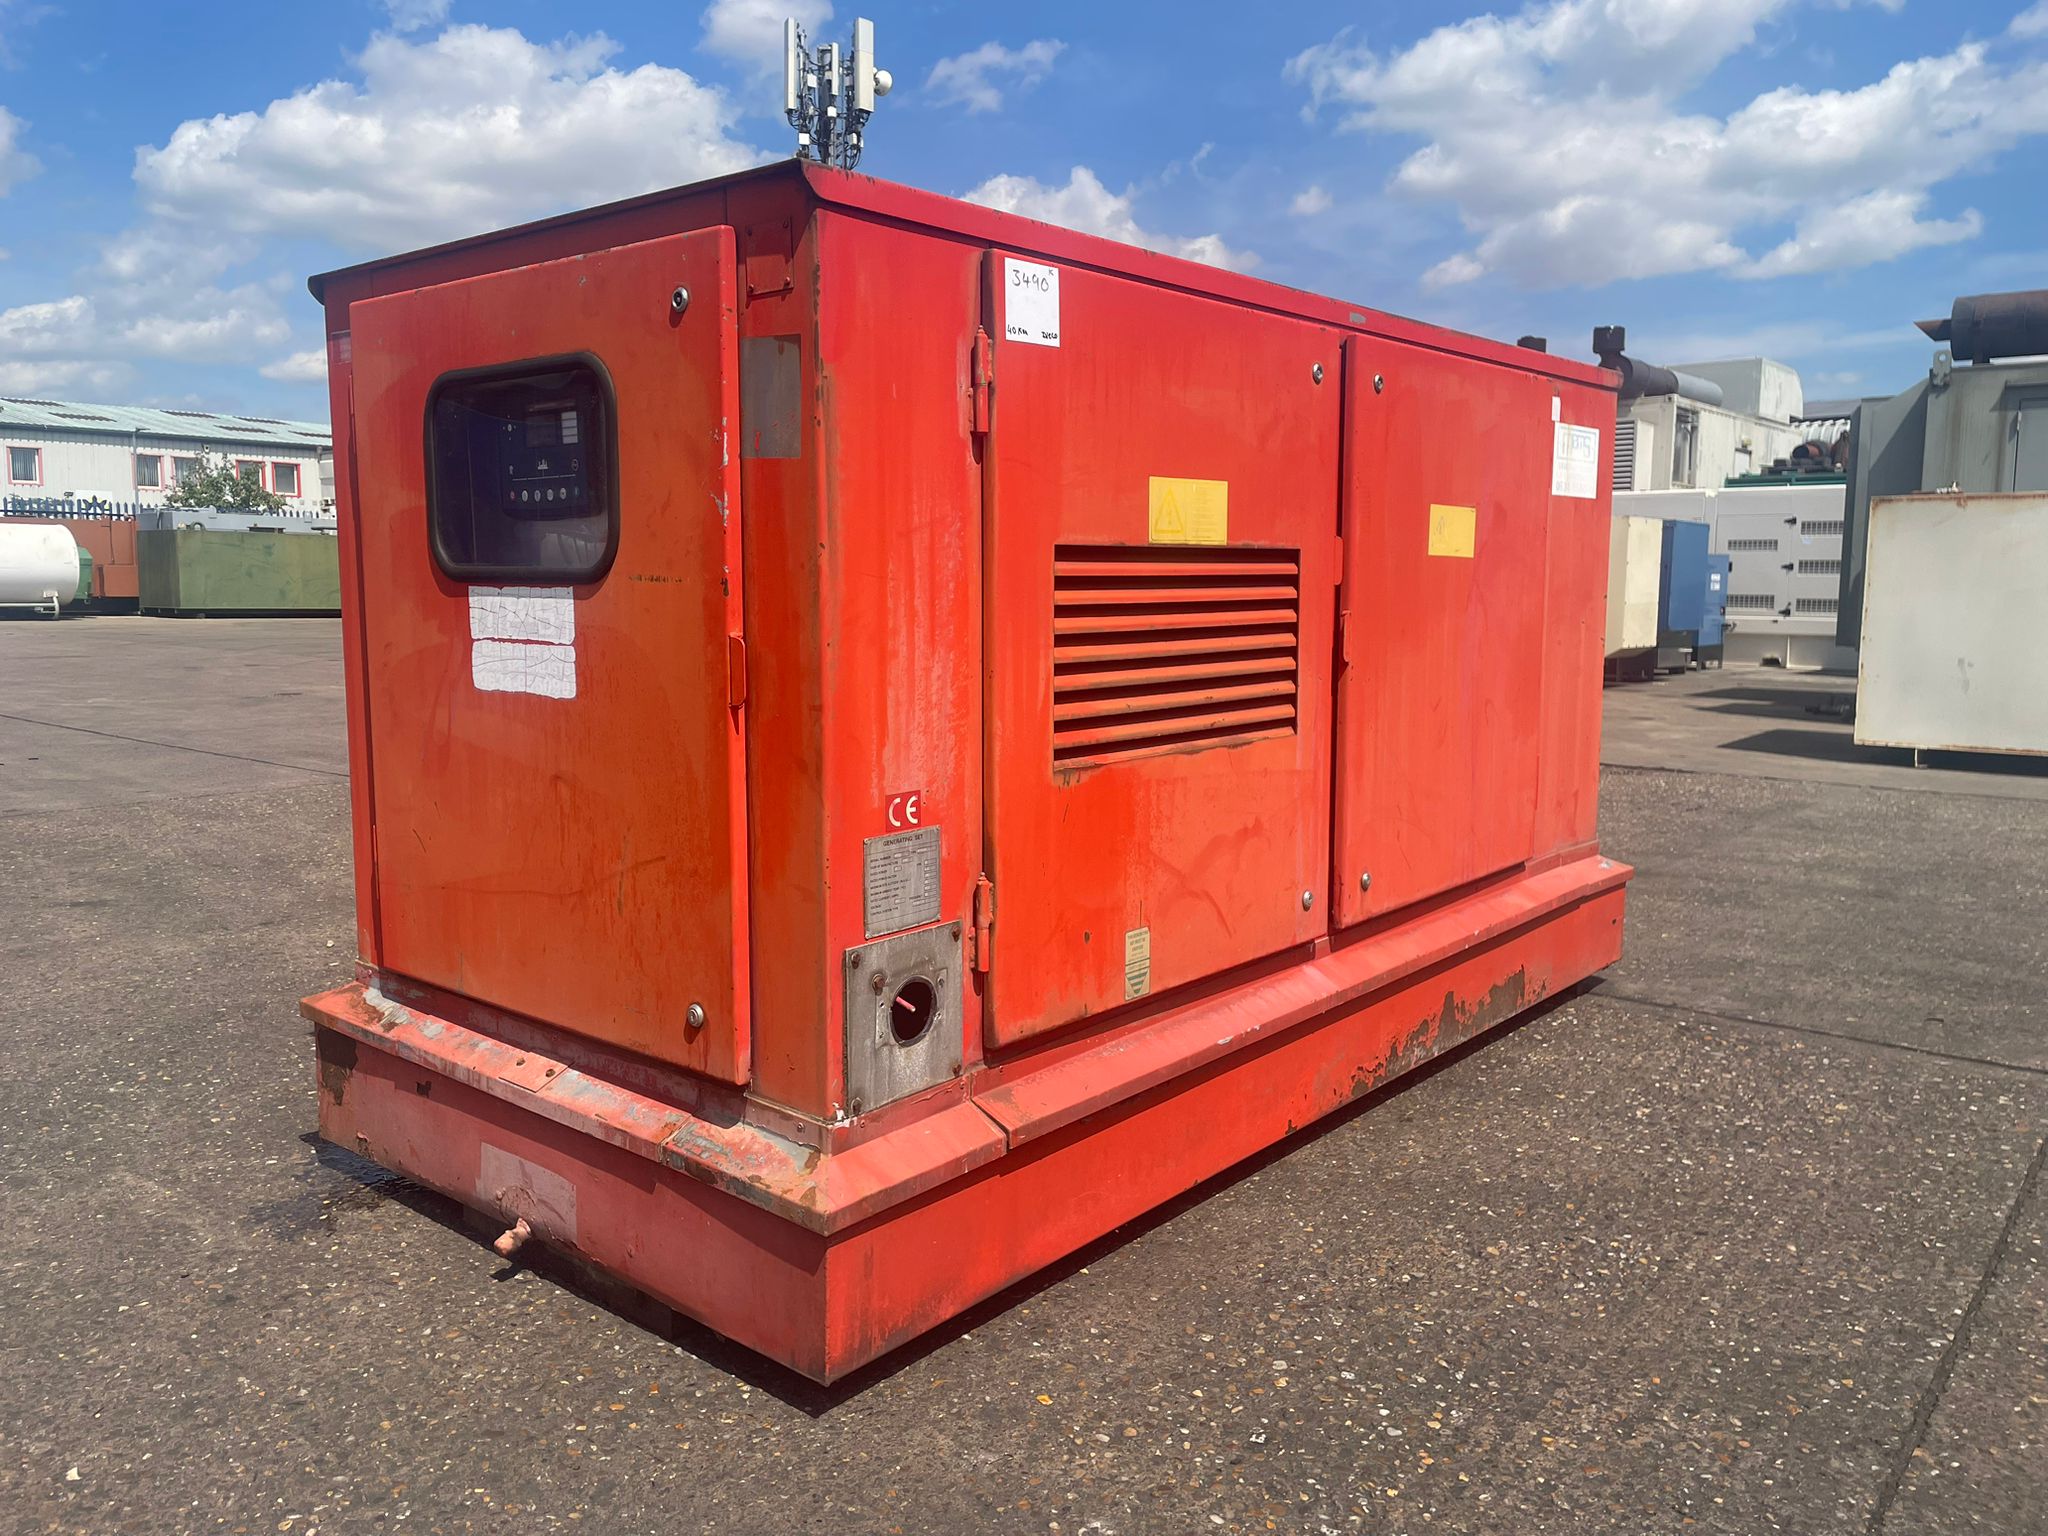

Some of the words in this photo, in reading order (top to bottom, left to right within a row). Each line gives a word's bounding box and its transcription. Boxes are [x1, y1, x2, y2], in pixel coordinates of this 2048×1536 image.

[1012, 269, 1049, 292] 3490
[888, 795, 919, 827] CE
[883, 836, 913, 847] GENERATING
[915, 833, 924, 841] SET
